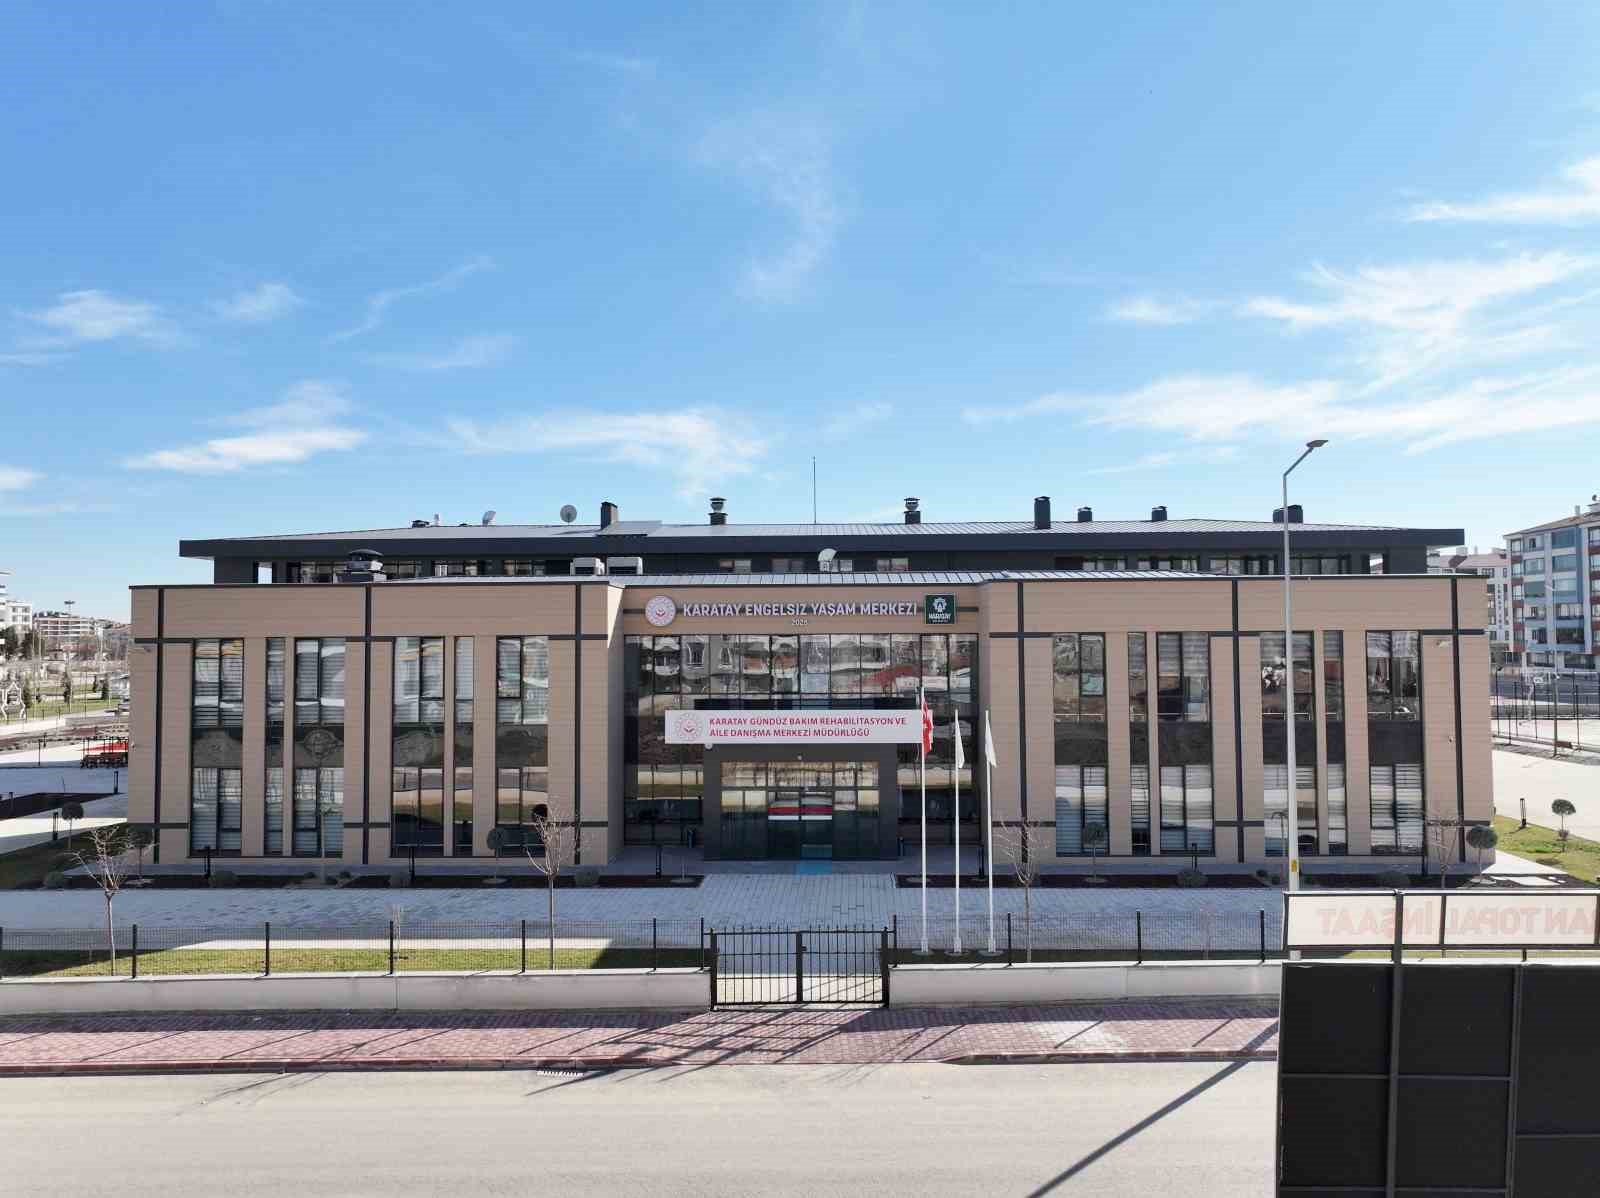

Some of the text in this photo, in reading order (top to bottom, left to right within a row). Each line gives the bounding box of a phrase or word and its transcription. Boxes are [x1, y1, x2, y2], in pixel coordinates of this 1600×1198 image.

[683, 603, 741, 616] KARATAY
[812, 602, 856, 617] YAŞAM
[709, 717, 747, 725] KARATAY
[789, 717, 818, 725] BAKIM
[895, 717, 906, 725] VE
[730, 729, 771, 738] DANIŞMA
[773, 728, 811, 737] MERKEZİ
[813, 727, 870, 737] MÜDÜRLÜĞÜ
